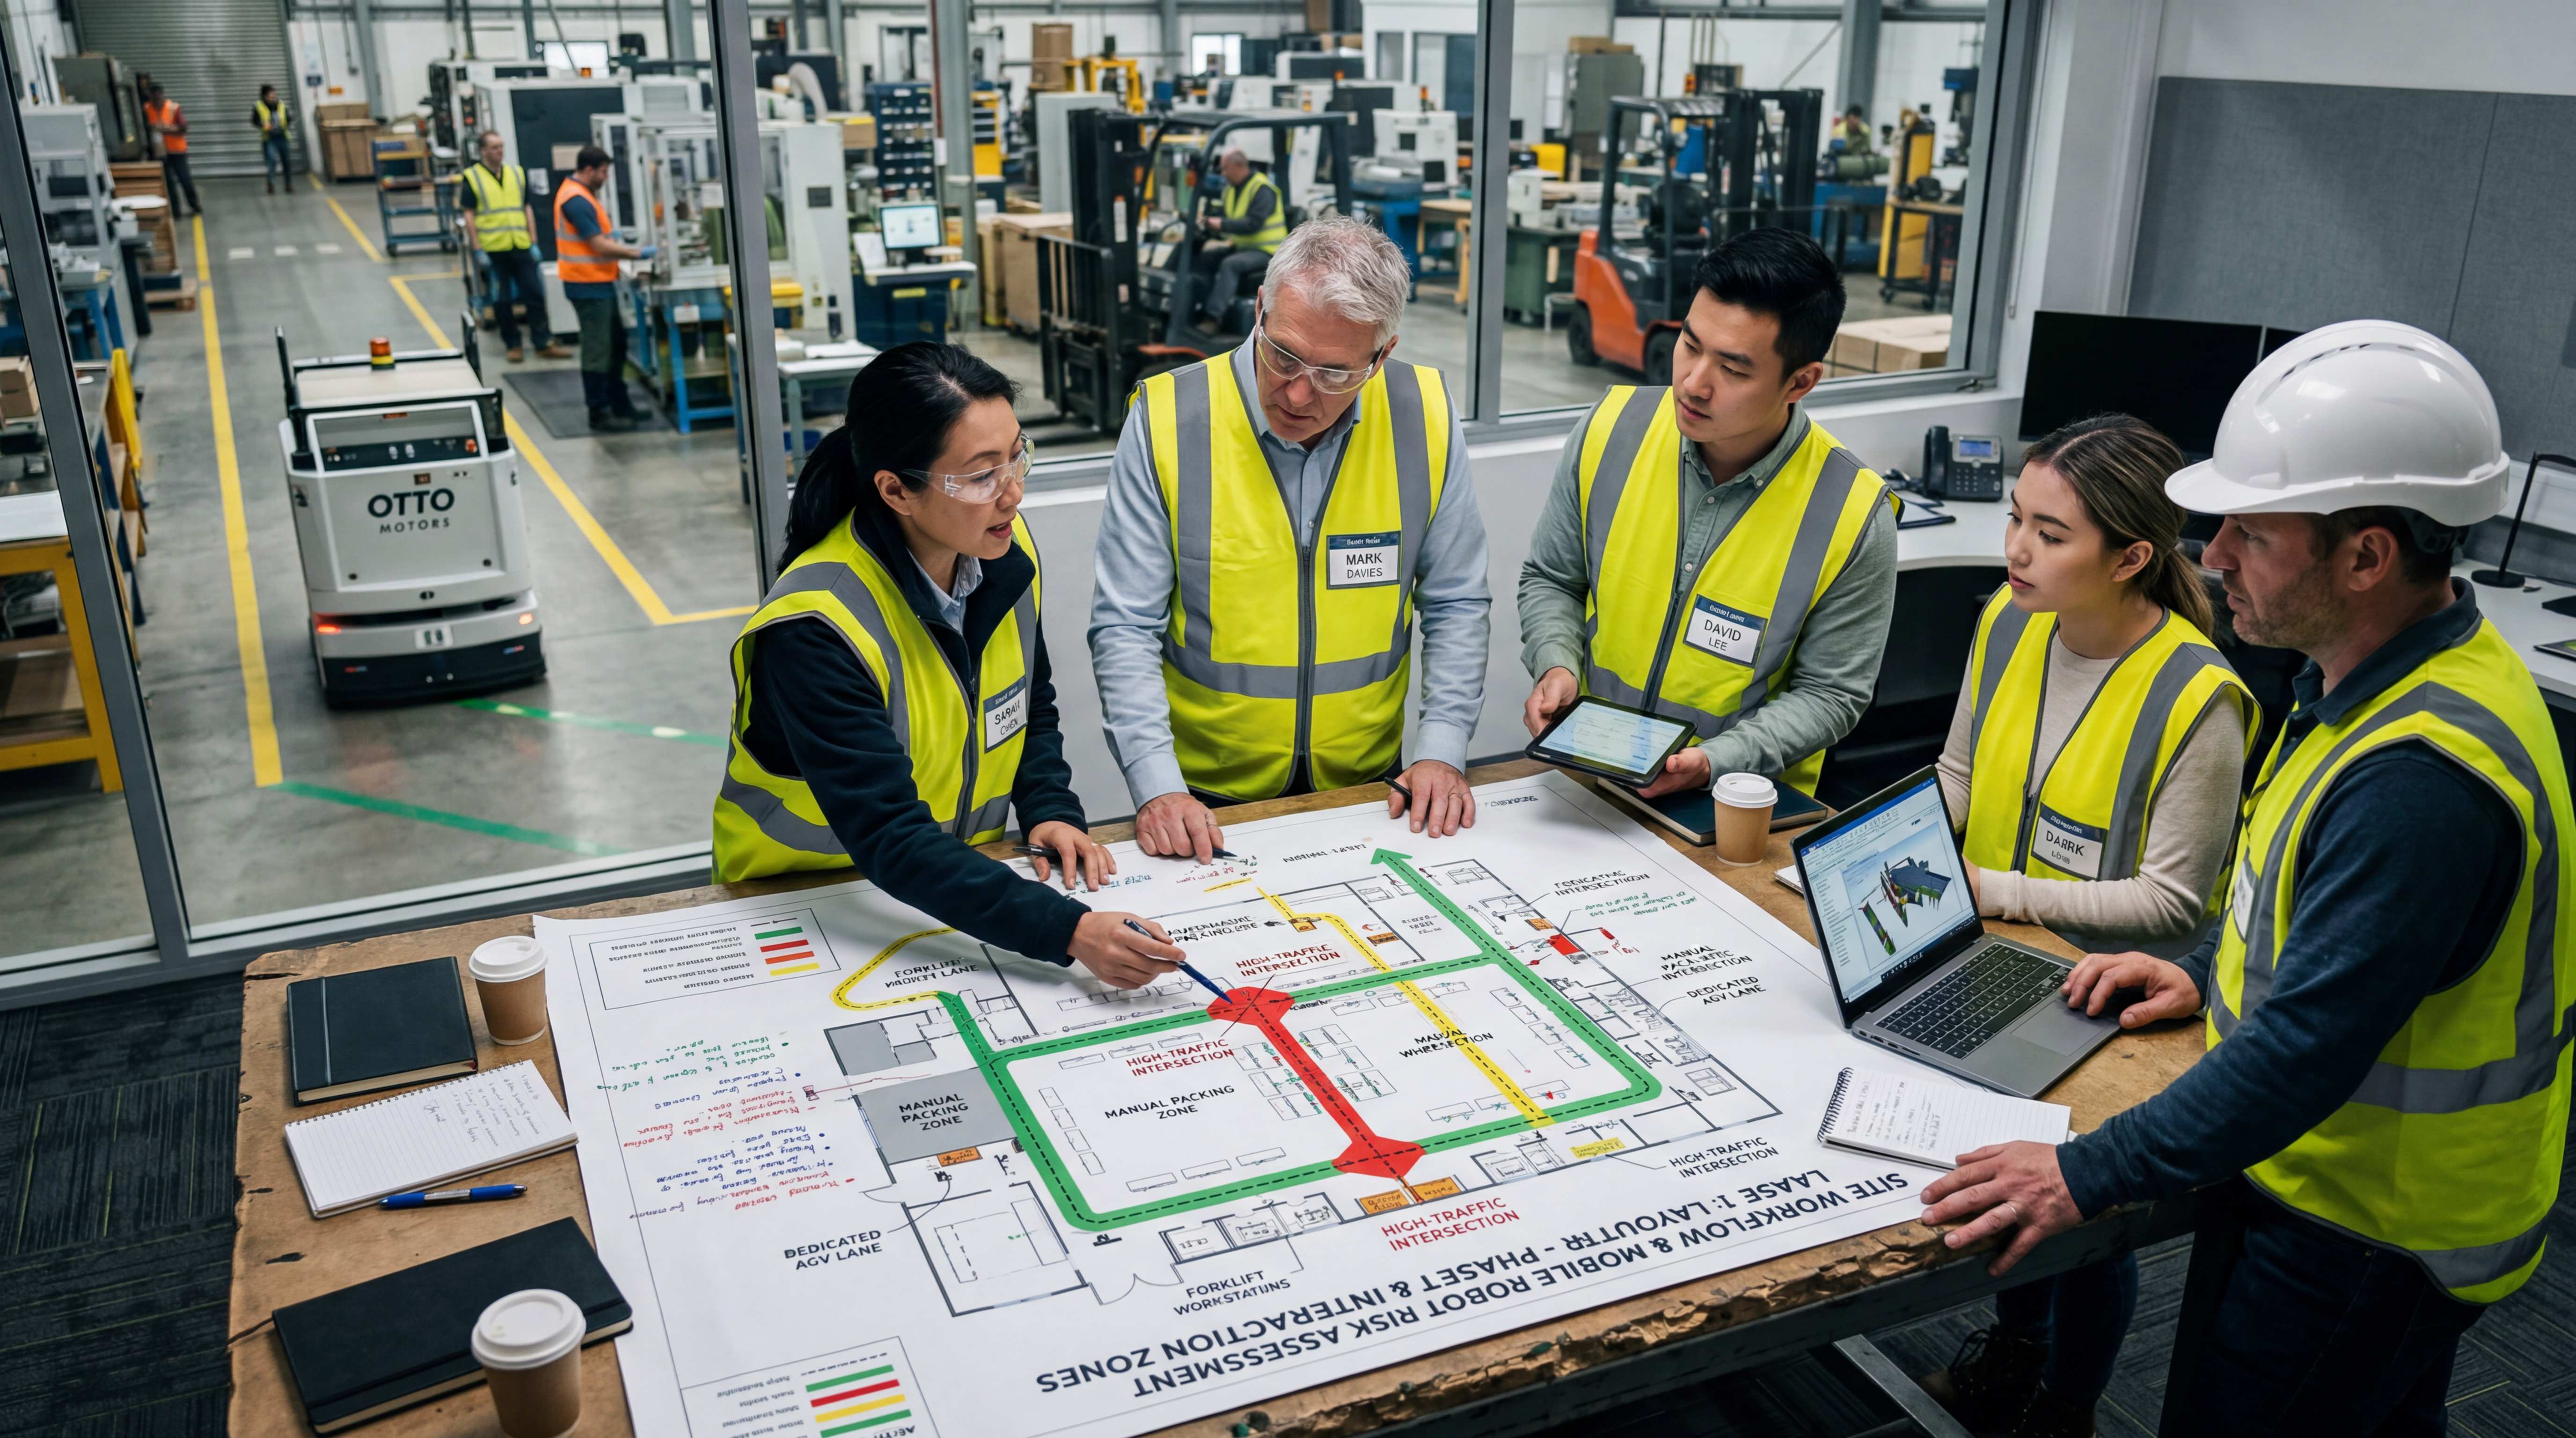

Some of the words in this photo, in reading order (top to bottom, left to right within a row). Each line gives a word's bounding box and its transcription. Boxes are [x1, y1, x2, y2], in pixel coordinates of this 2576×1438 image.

[368, 488, 454, 518] OTTO
[380, 517, 450, 534] MOTORS
[1346, 553, 1383, 565] MARK
[1347, 567, 1383, 579] DAVIES
[1704, 619, 1741, 641] DAVID
[1709, 637, 1727, 651] LEE
[941, 964, 980, 977] LANE
[1240, 951, 1341, 977] INTERSECTION
[1686, 976, 1759, 998] DEDICATED
[1703, 993, 1727, 1005] AGV
[1132, 1049, 1235, 1077] INTERSECTION
[899, 1093, 965, 1113] MANUAL
[901, 1103, 969, 1123] PACKING
[1105, 1100, 1169, 1119] MANUAL
[1170, 1085, 1235, 1105] PACKING
[1156, 1105, 1199, 1119] ZONE
[919, 1115, 963, 1131] ZONE
[1669, 1137, 1768, 1167] HIGH-TRAFFIC
[1679, 1147, 1779, 1178] INTERSECTION
[1737, 1169, 1830, 1203] LAASE
[1844, 1173, 1908, 1200] SITE
[1711, 1194, 1737, 1210] 1:
[1381, 1197, 1507, 1237] HIGH-TRAFFIC
[1389, 1210, 1520, 1251] INTERSECTION
[1679, 1190, 1850, 1247] WORKFLOW
[784, 1230, 881, 1259] DEDICATED
[796, 1253, 830, 1270] AGV
[836, 1242, 883, 1261] LANE
[1648, 1237, 1674, 1254] &
[1420, 1247, 1540, 1292] PHASET
[1531, 1243, 1648, 1286] MOBILE
[1186, 1270, 1264, 1299] FORKLIFT
[1389, 1281, 1412, 1298] &
[1426, 1276, 1532, 1318] ROBOT
[1161, 1288, 1387, 1360] INTERACTION
[1346, 1306, 1420, 1339] RISK
[1036, 1347, 1156, 1393] ZONES
[1134, 1326, 1339, 1397] ASSESSMENT
